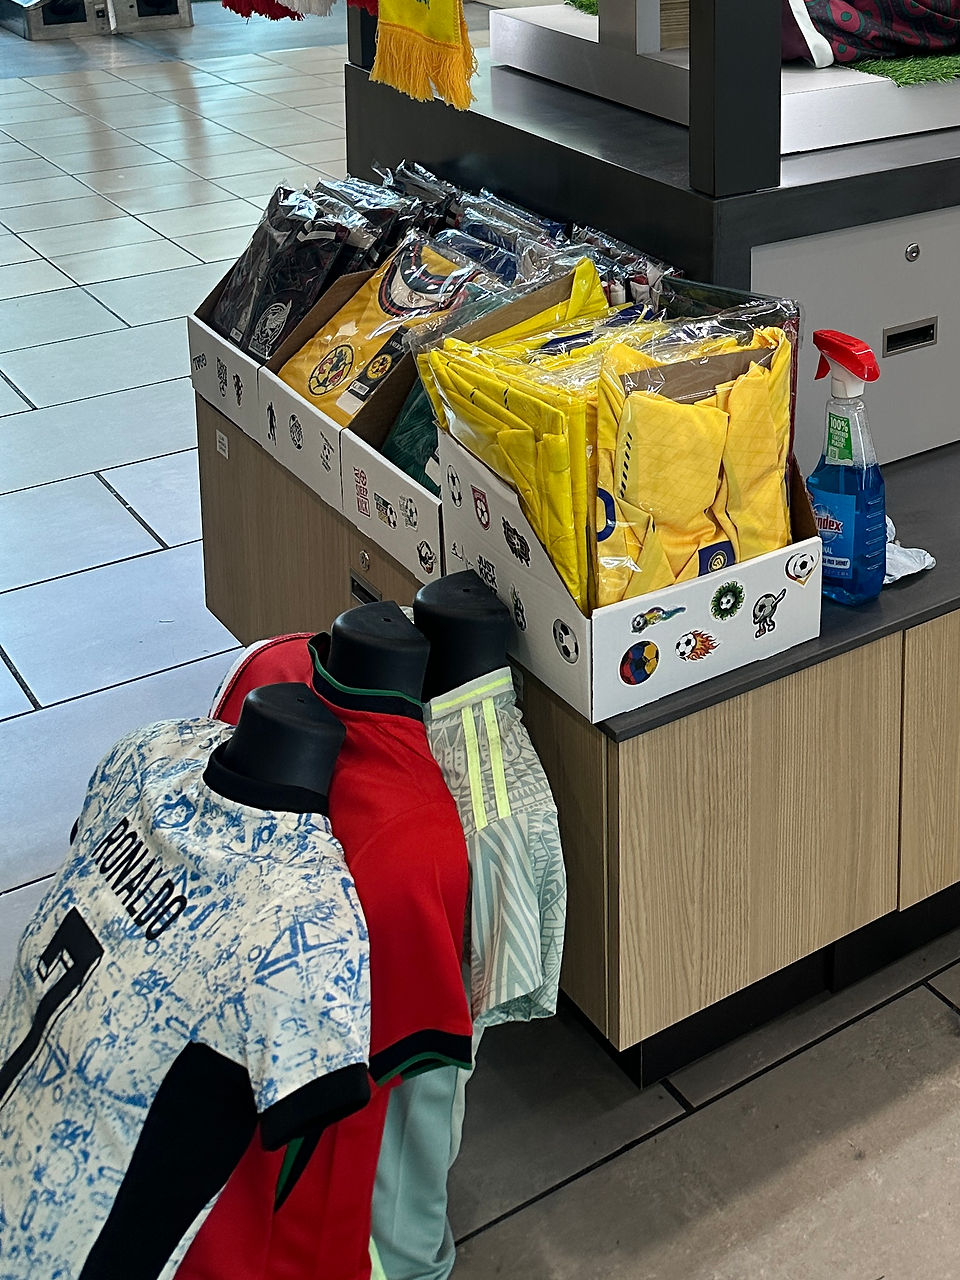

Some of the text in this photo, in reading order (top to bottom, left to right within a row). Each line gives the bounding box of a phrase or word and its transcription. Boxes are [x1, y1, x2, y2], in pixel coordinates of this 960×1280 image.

[830, 416, 849, 433] 100%
[91, 816, 188, 941] RONALDO
[0, 906, 105, 1113] 7
